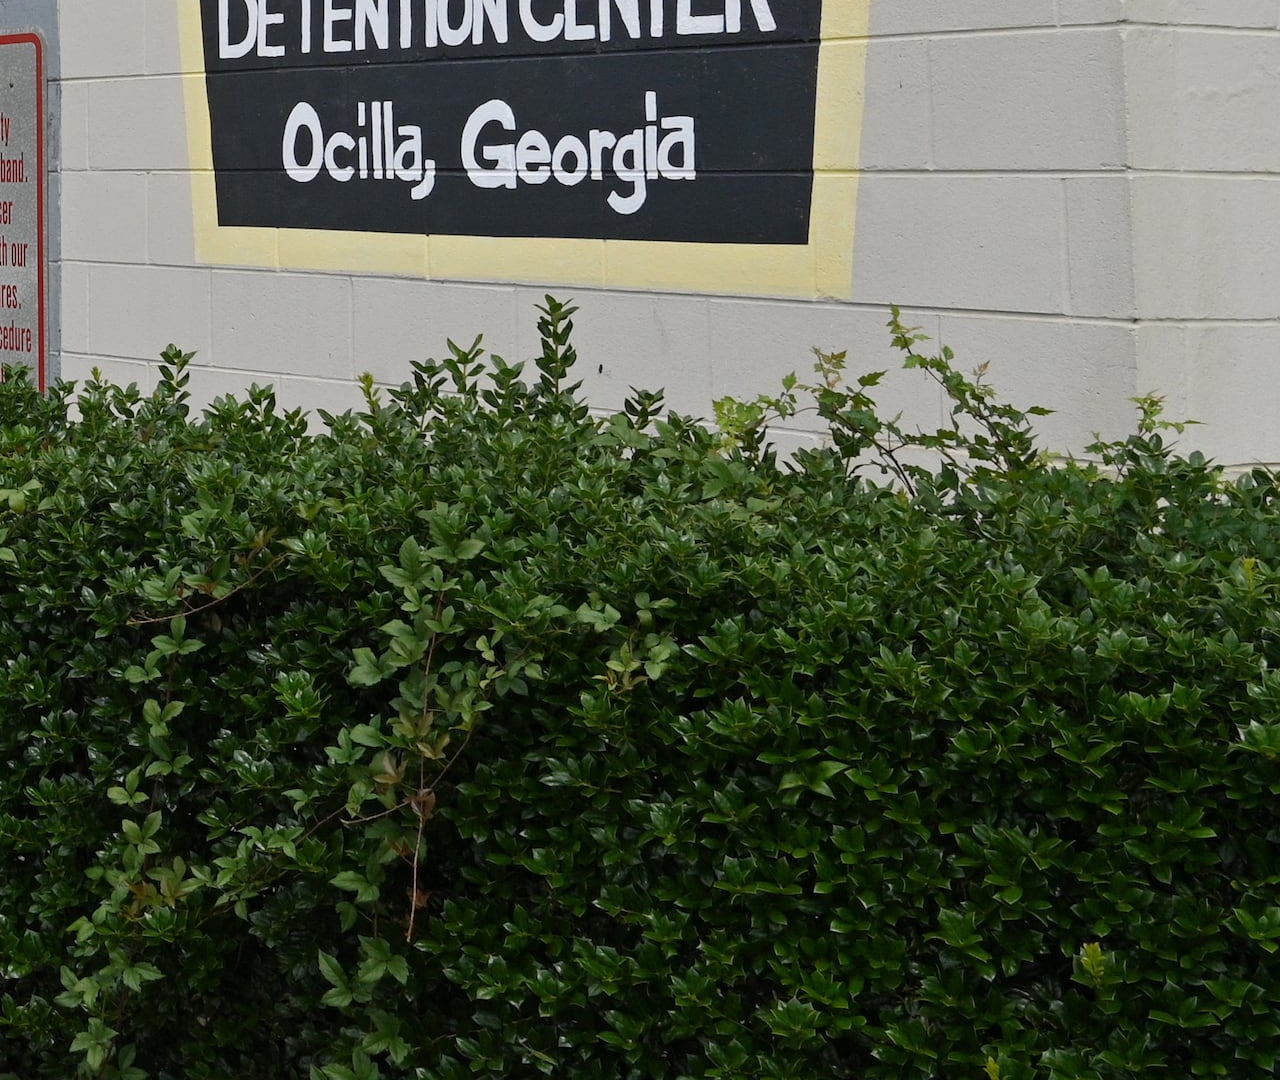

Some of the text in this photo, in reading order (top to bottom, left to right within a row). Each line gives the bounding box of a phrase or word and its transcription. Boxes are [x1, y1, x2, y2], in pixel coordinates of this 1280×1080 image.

[282, 91, 697, 215] Ocilla, Georgia
[11, 242, 28, 268] our
